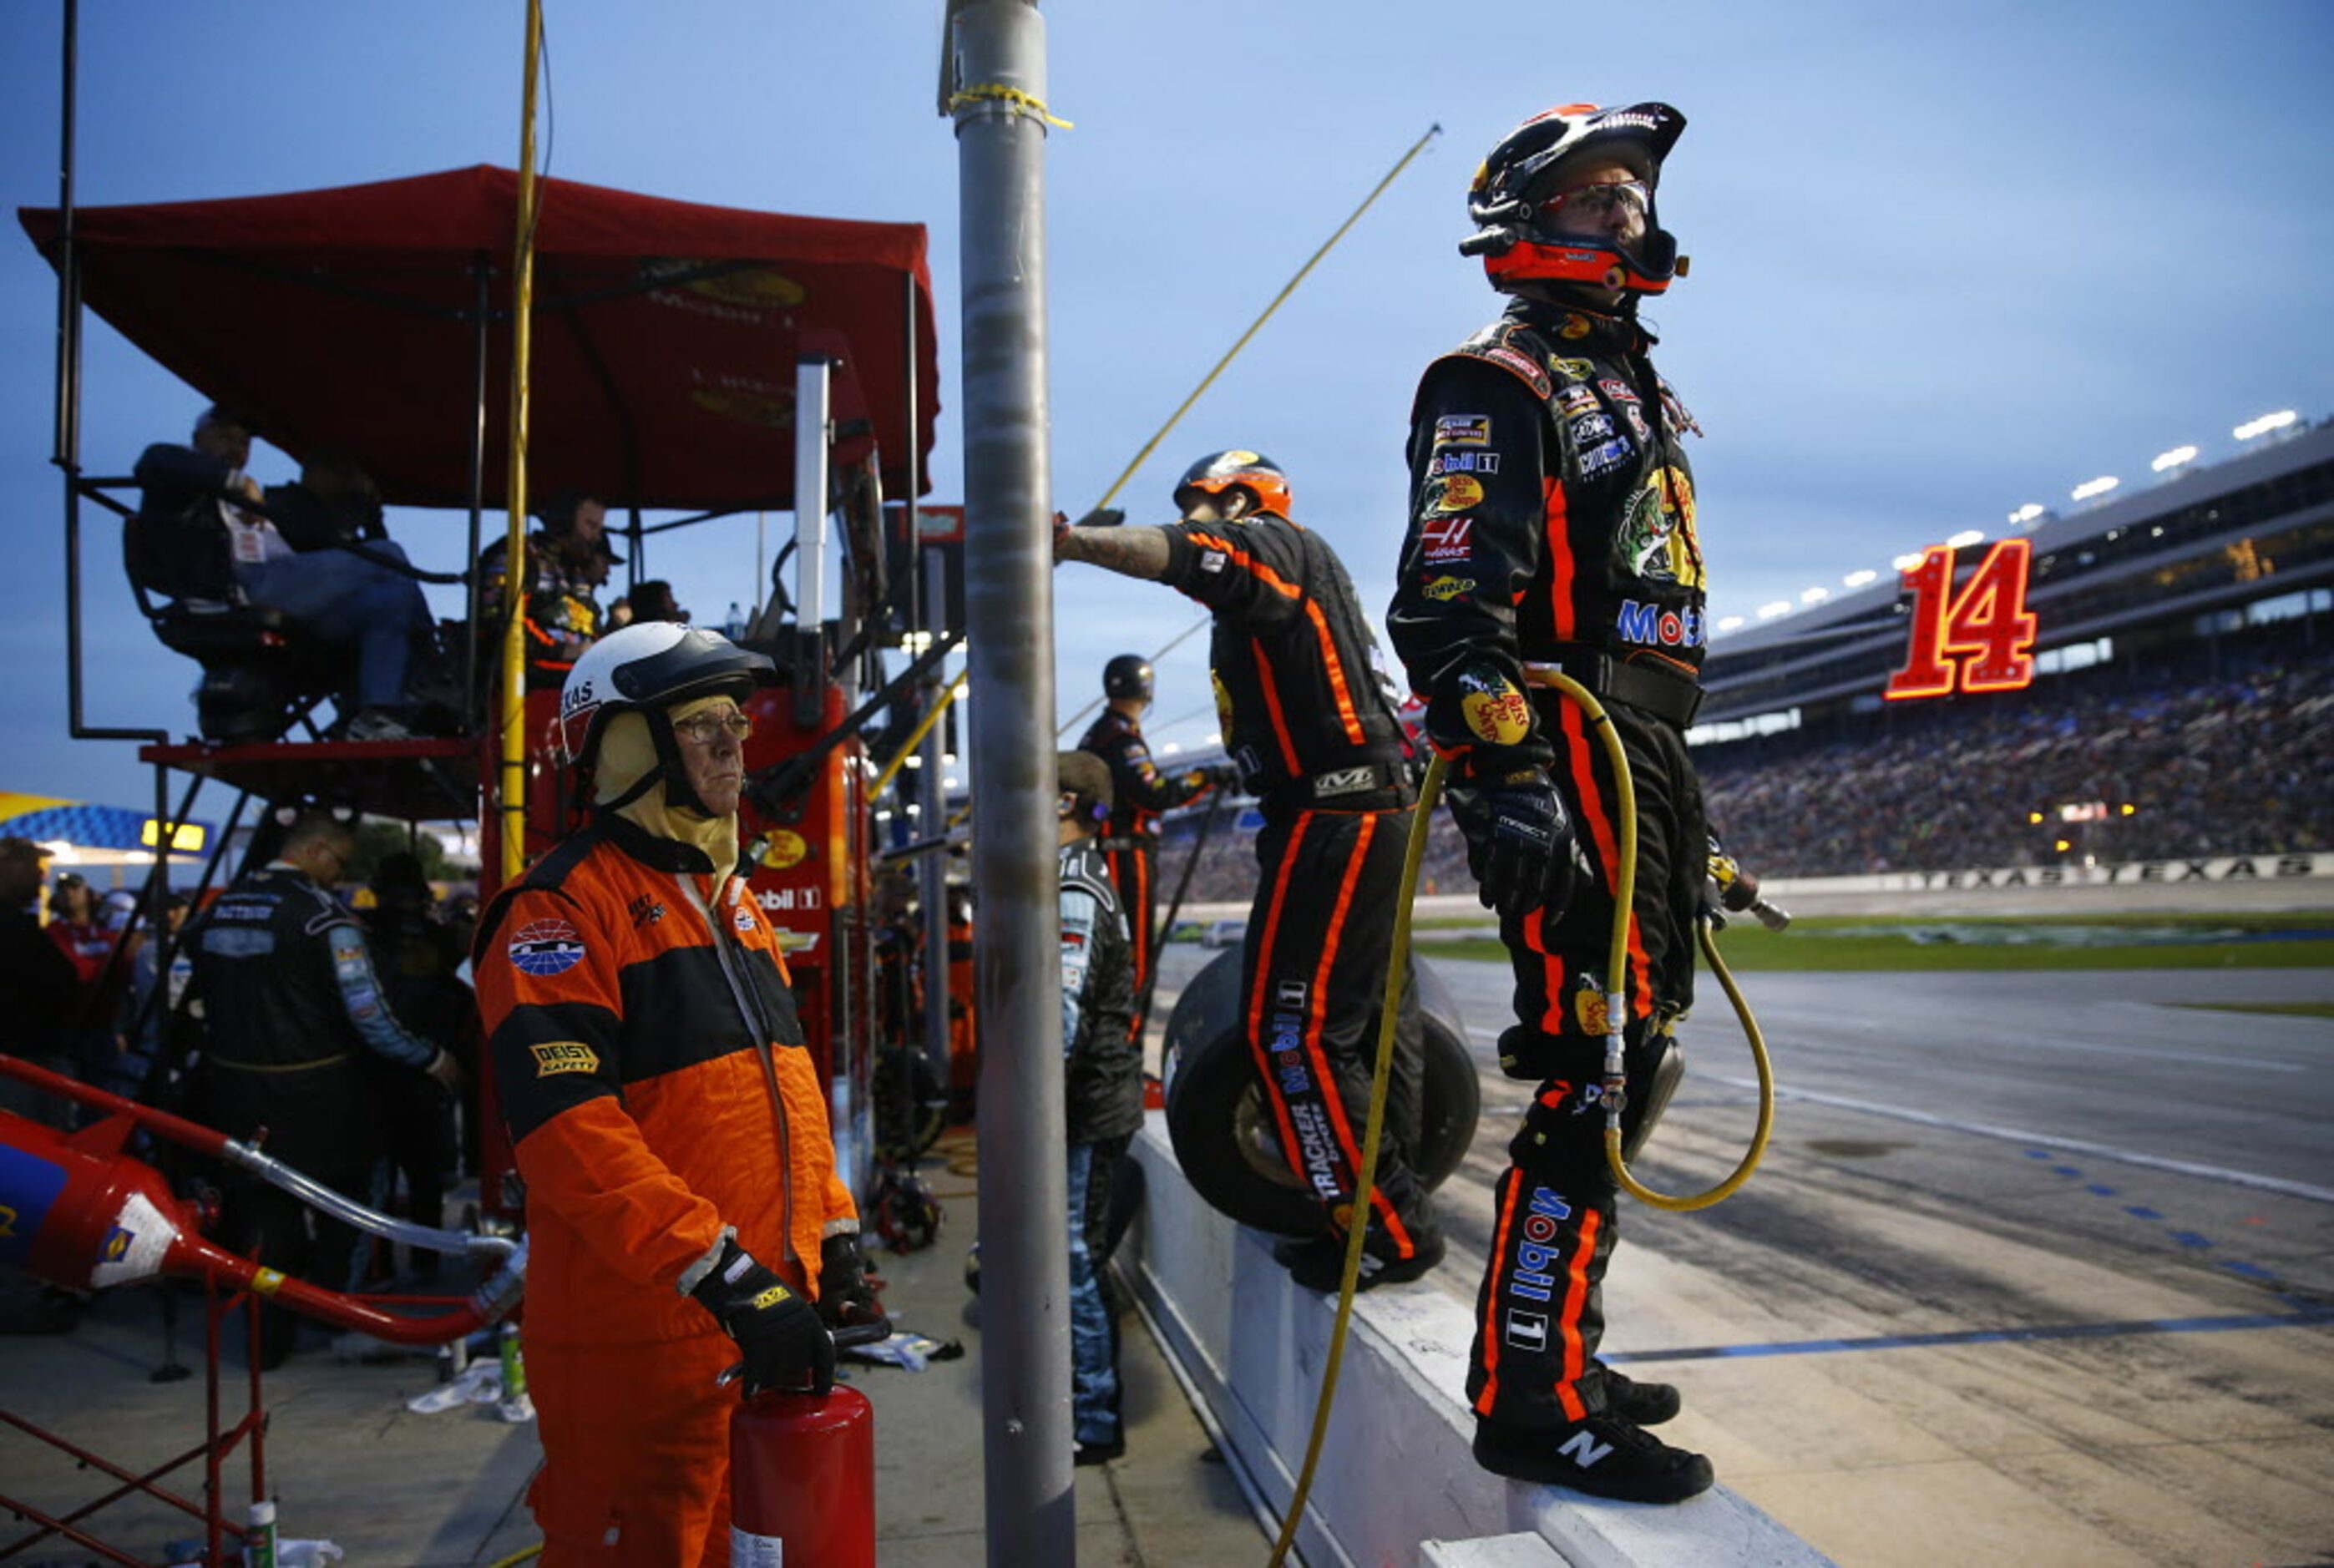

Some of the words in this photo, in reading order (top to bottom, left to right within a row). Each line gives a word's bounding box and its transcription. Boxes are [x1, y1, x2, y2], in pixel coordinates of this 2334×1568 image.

[1883, 538, 2038, 701] 14
[2096, 857, 2313, 883] TEXAS
[537, 1044, 595, 1060] DEIST
[1271, 1012, 1311, 1095] Mobil
[1291, 1103, 1341, 1201] TRACKER
[1510, 1186, 1572, 1302] Mobil
